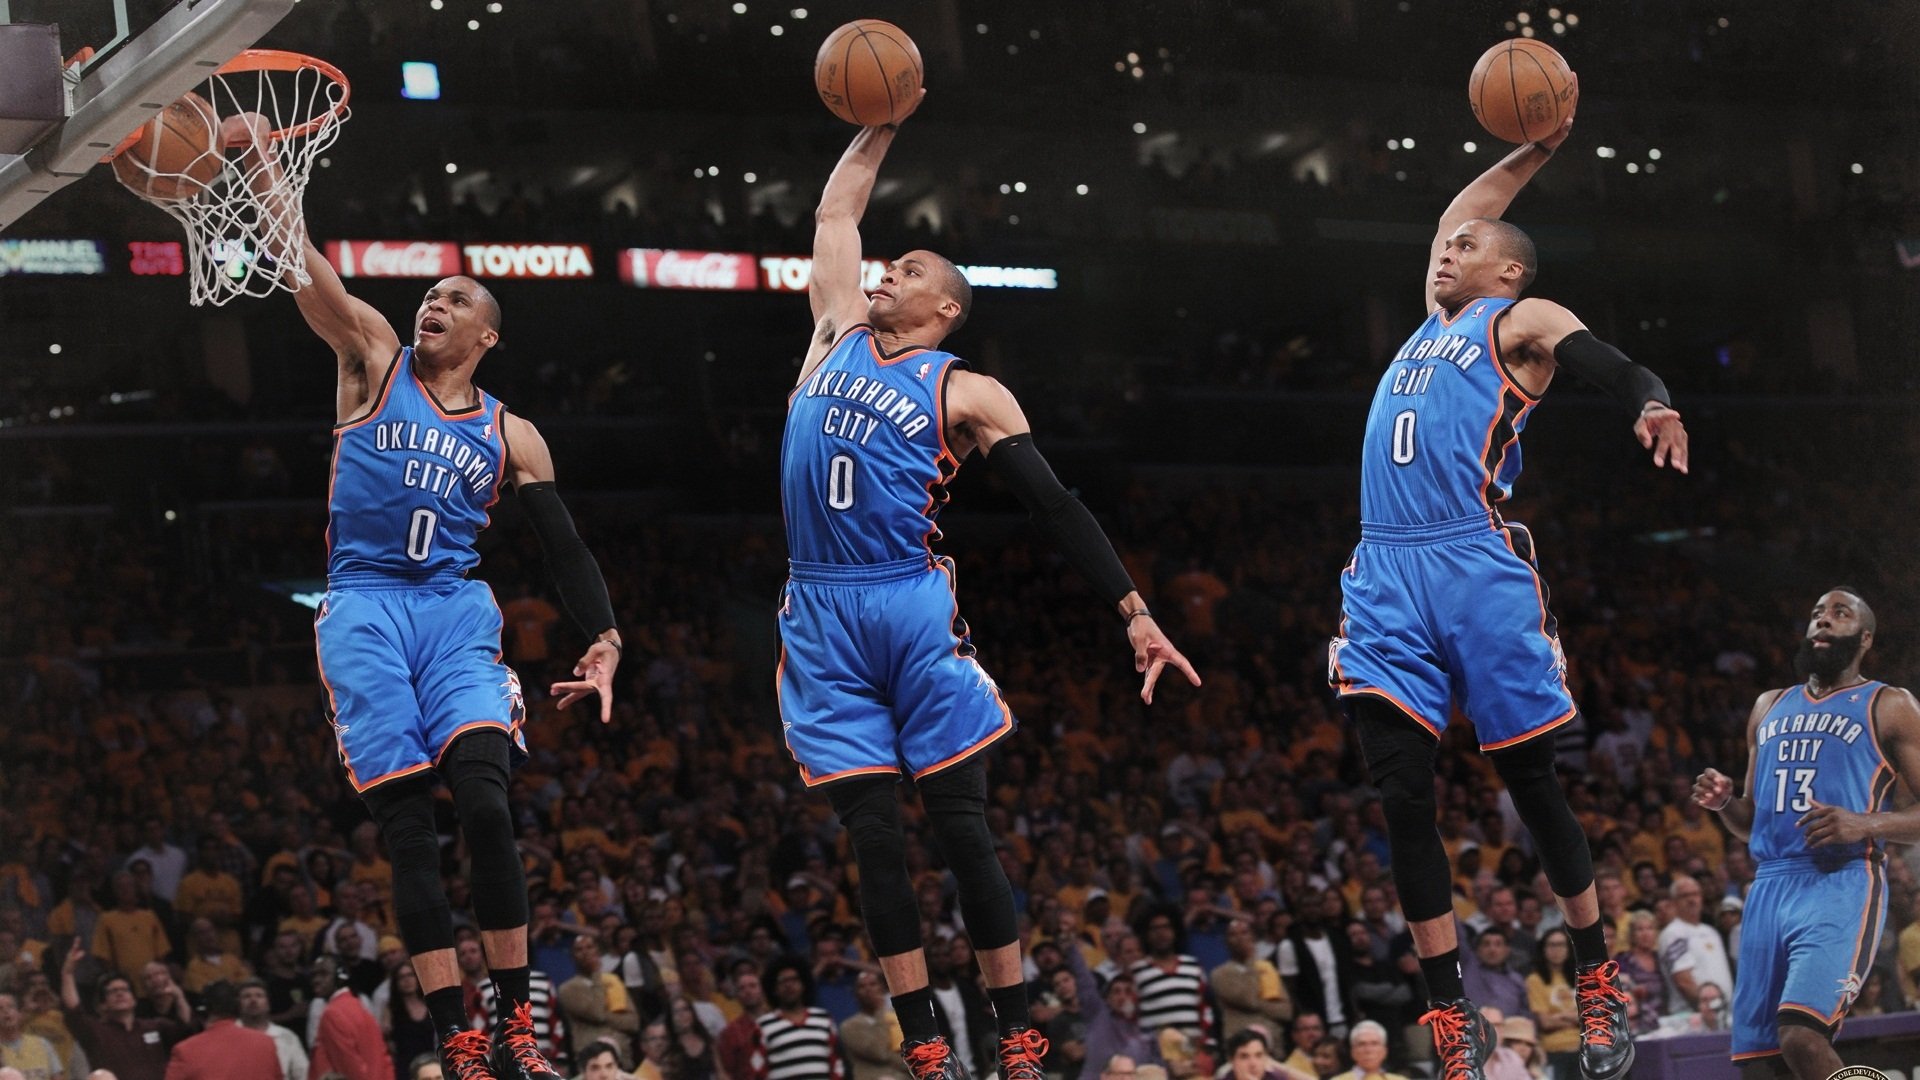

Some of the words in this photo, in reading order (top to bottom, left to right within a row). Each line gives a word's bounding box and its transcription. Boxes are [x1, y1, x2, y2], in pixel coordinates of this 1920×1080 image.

[463, 244, 593, 277] TOYOTA
[760, 257, 886, 291] TOA
[1391, 366, 1436, 396] CITY
[806, 371, 930, 440] OKLAHOMA
[823, 406, 880, 447] CITY
[375, 421, 495, 495] OKLAHOMA
[1392, 408, 1417, 466] 0
[403, 458, 461, 500] CITY
[828, 453, 855, 511] 0
[406, 506, 438, 562] 0
[1758, 712, 1864, 746] OKLAHOMA
[1777, 738, 1824, 763] CITY
[1775, 768, 1816, 814] 13
